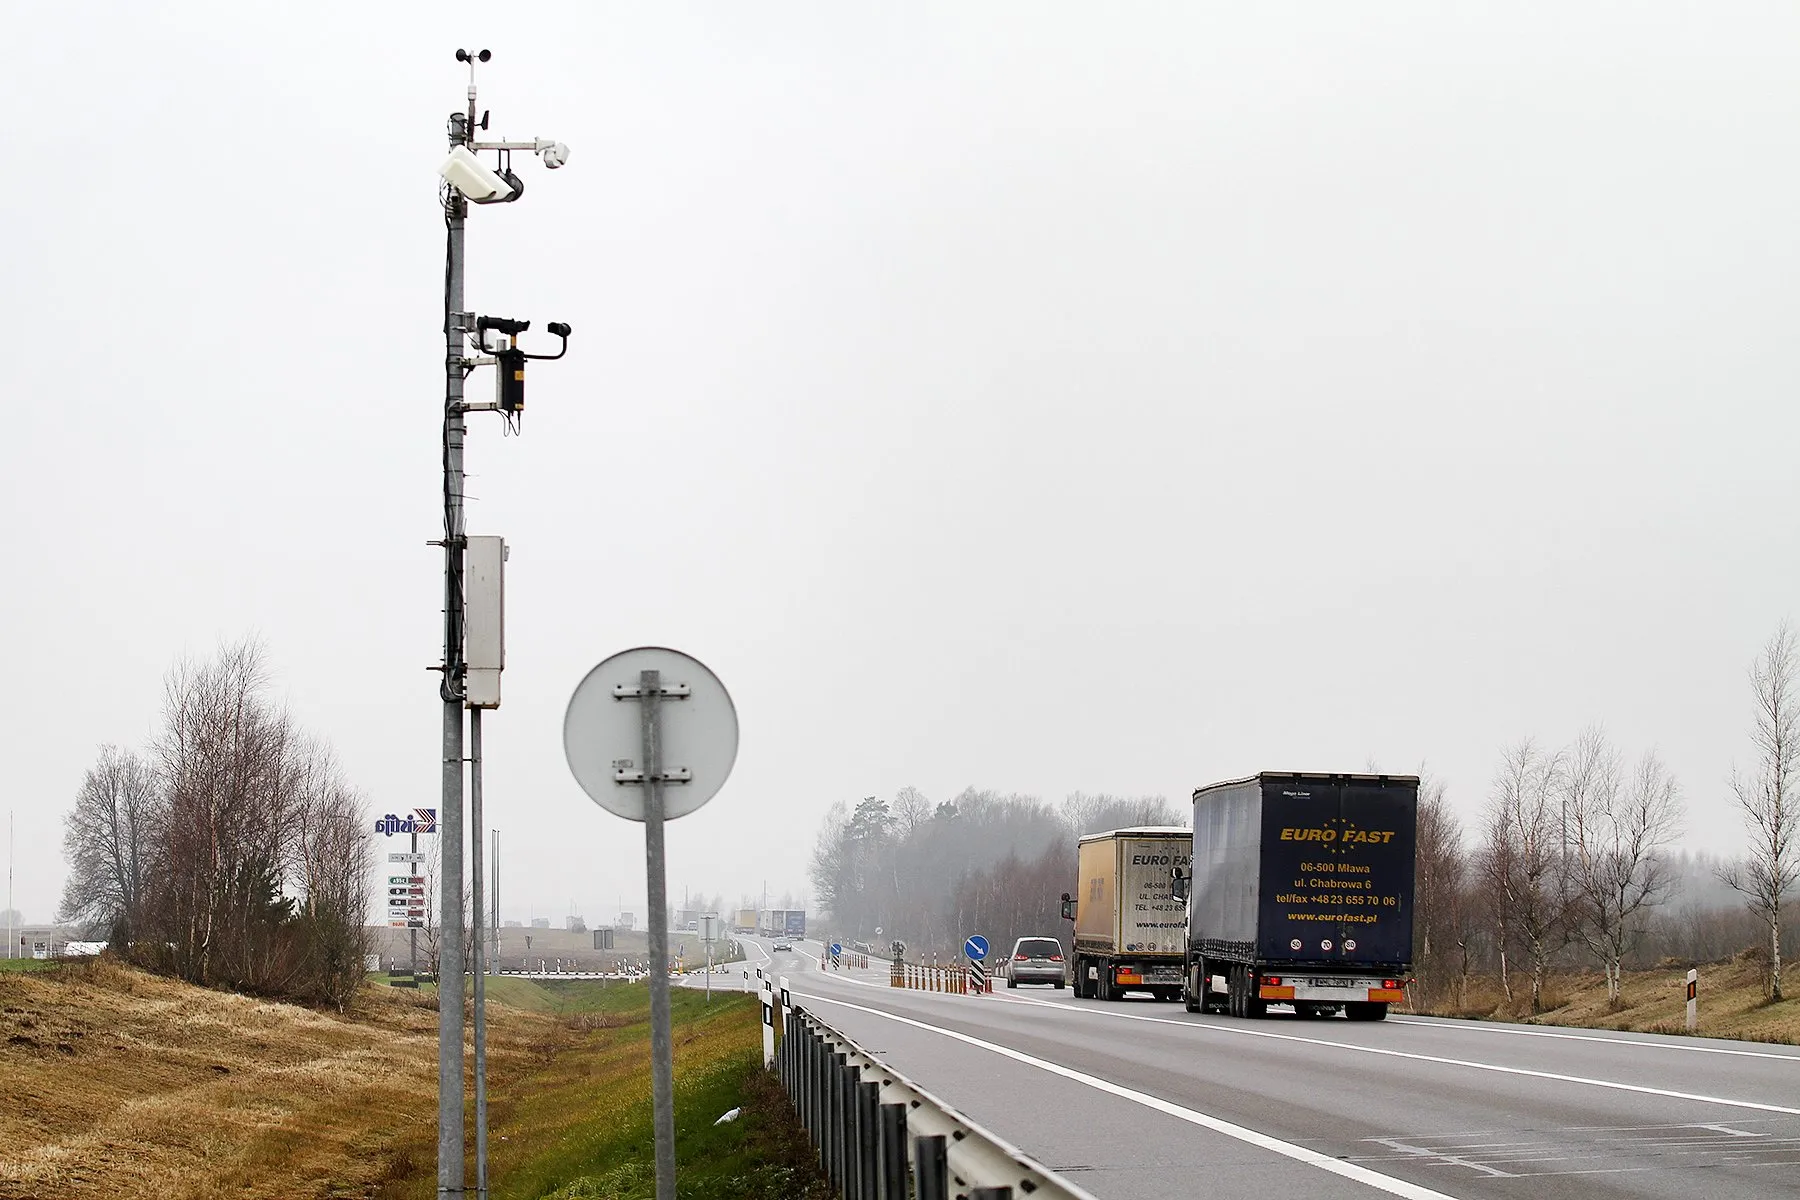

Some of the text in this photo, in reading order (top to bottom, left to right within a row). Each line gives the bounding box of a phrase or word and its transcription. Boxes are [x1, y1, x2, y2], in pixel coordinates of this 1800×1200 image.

[1280, 828, 1395, 844] EURO FAST
[1132, 855, 1191, 866] EURO FA
[1300, 862, 1335, 873] 06-500
[1294, 879, 1372, 889] ul. Chabrowa 6
[1276, 894, 1396, 906] tel/fax +48 23 655 70 06
[1287, 912, 1378, 924] www.eurofast.pl
[1136, 921, 1186, 929] www.eurofa
